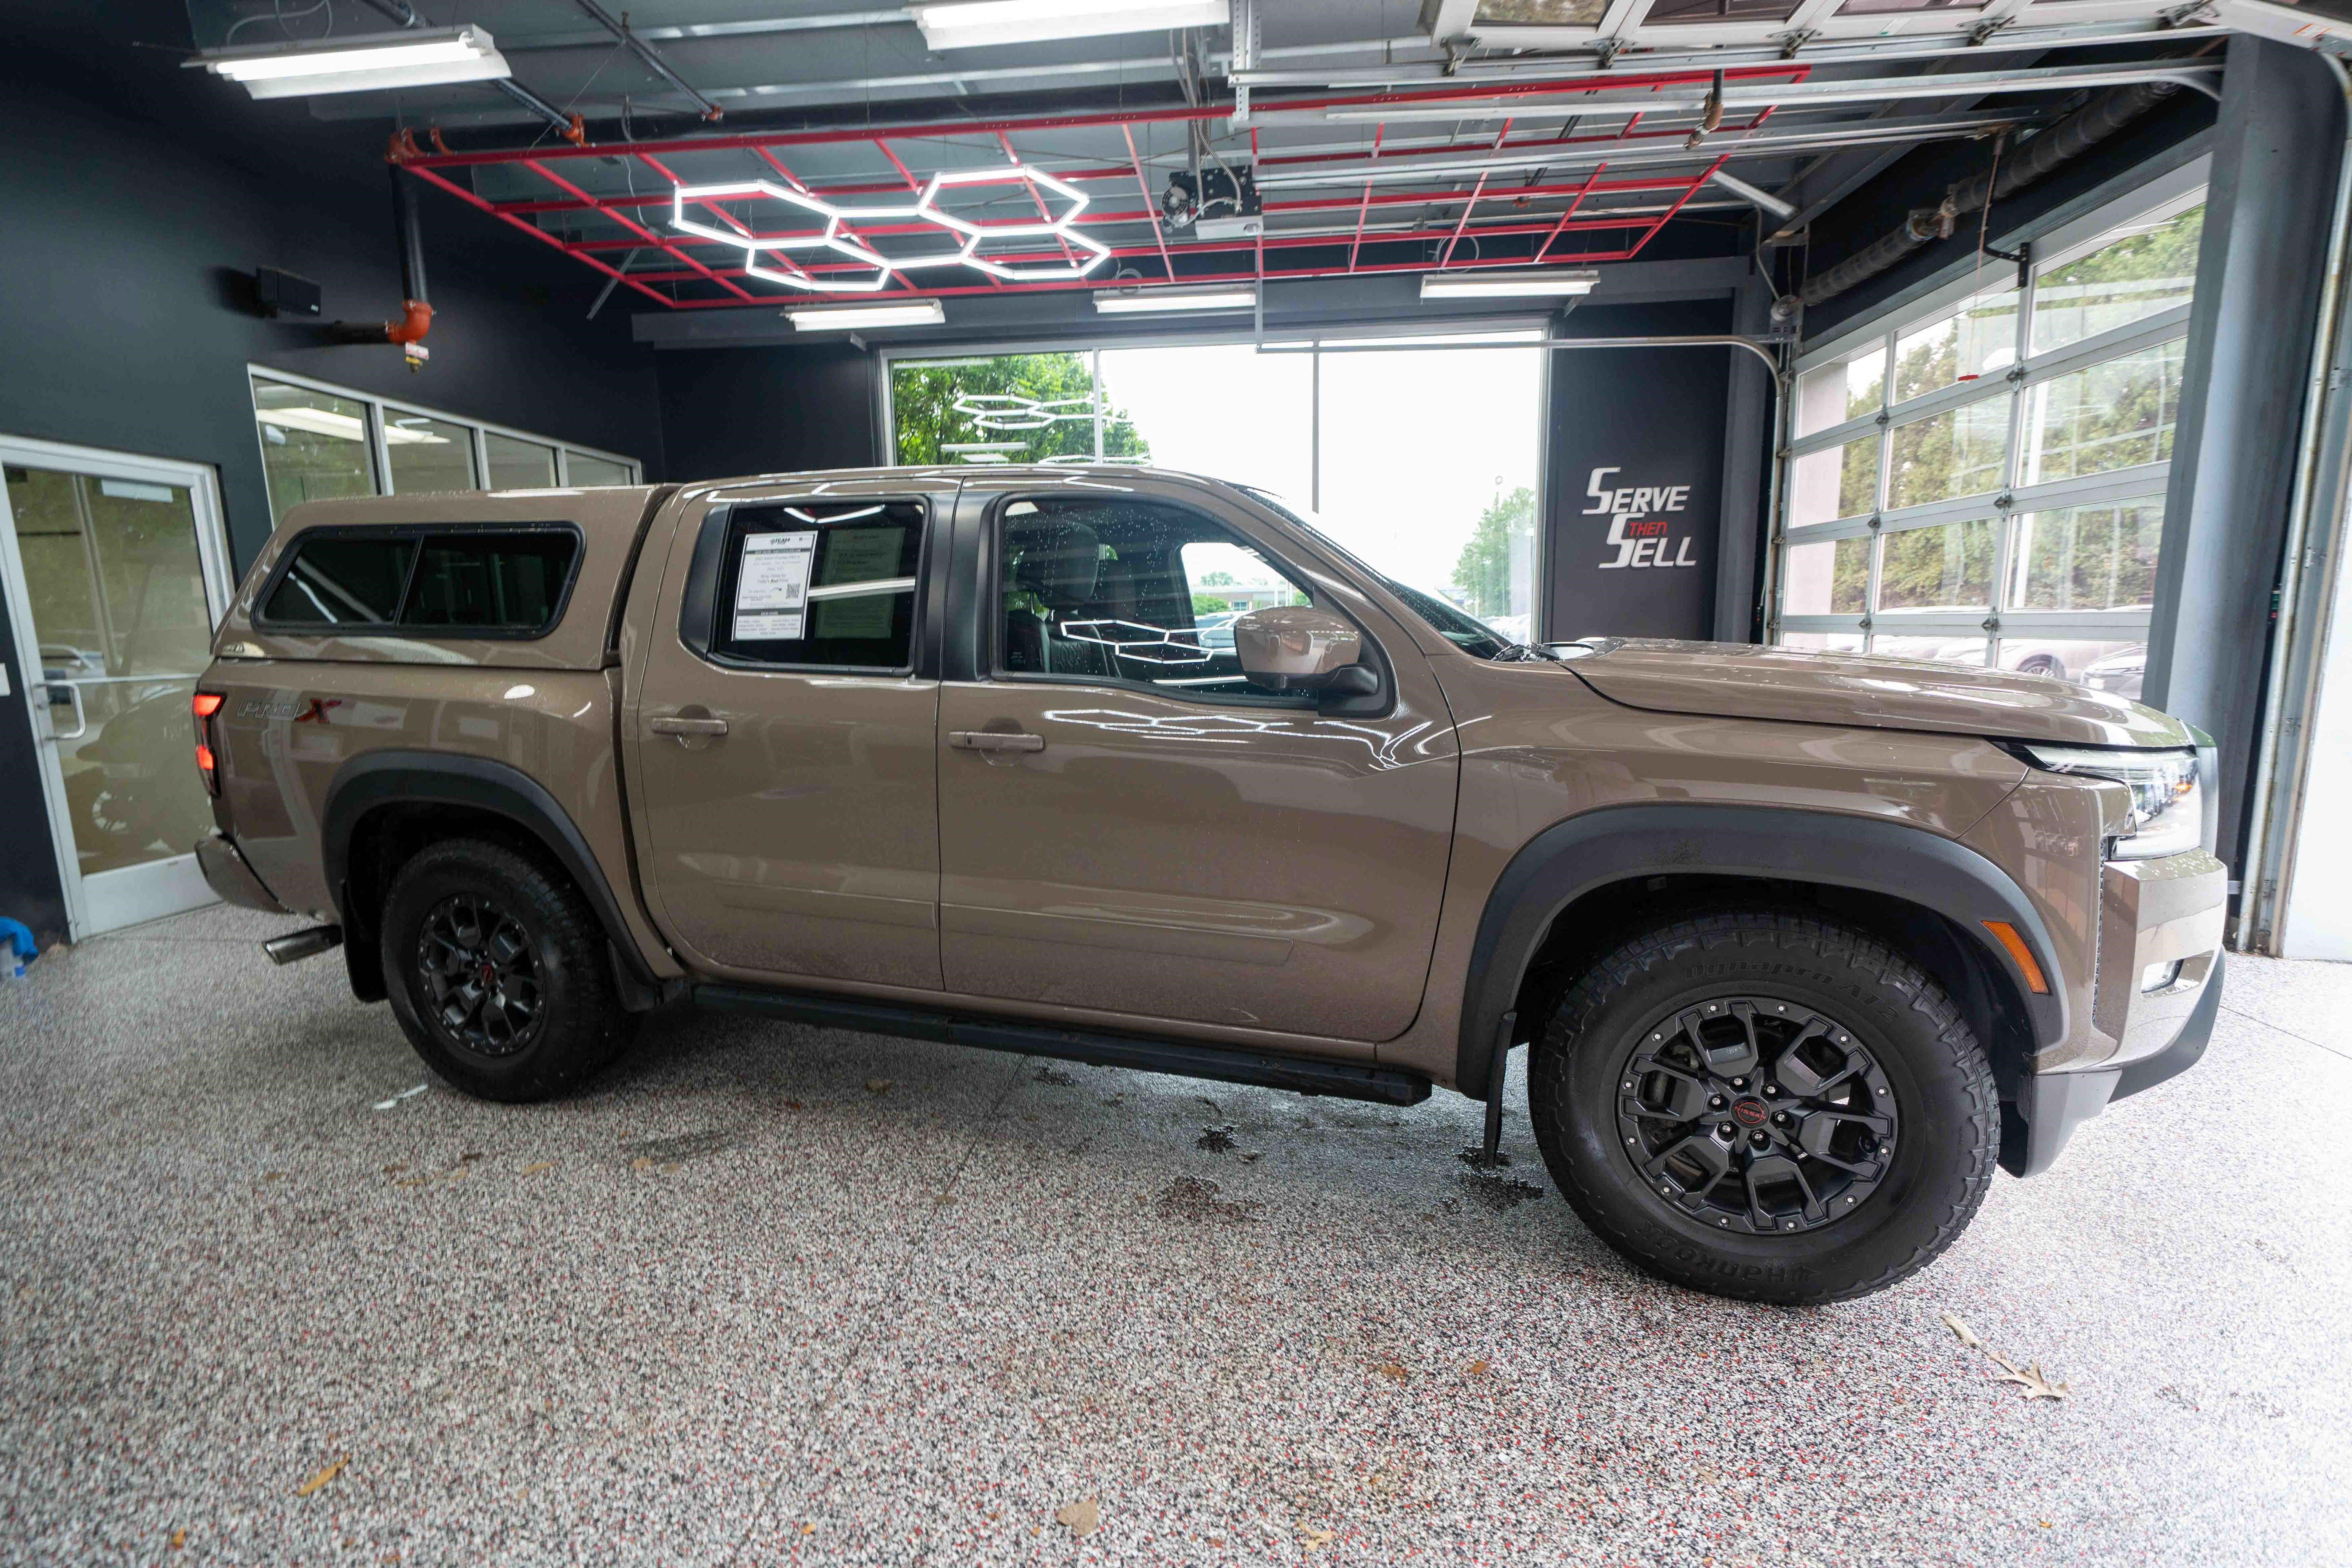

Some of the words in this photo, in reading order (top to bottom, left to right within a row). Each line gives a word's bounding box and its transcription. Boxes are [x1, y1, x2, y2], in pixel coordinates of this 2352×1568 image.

[1582, 467, 1691, 514] SERVE
[1598, 512, 1697, 568] SELL
[1629, 521, 1668, 536] THEN
[1684, 960, 1835, 984] Dynapro
[1835, 983, 1885, 1006] AT
[1875, 1007, 1901, 1022] 2
[1734, 1106, 1767, 1120] NISSAN
